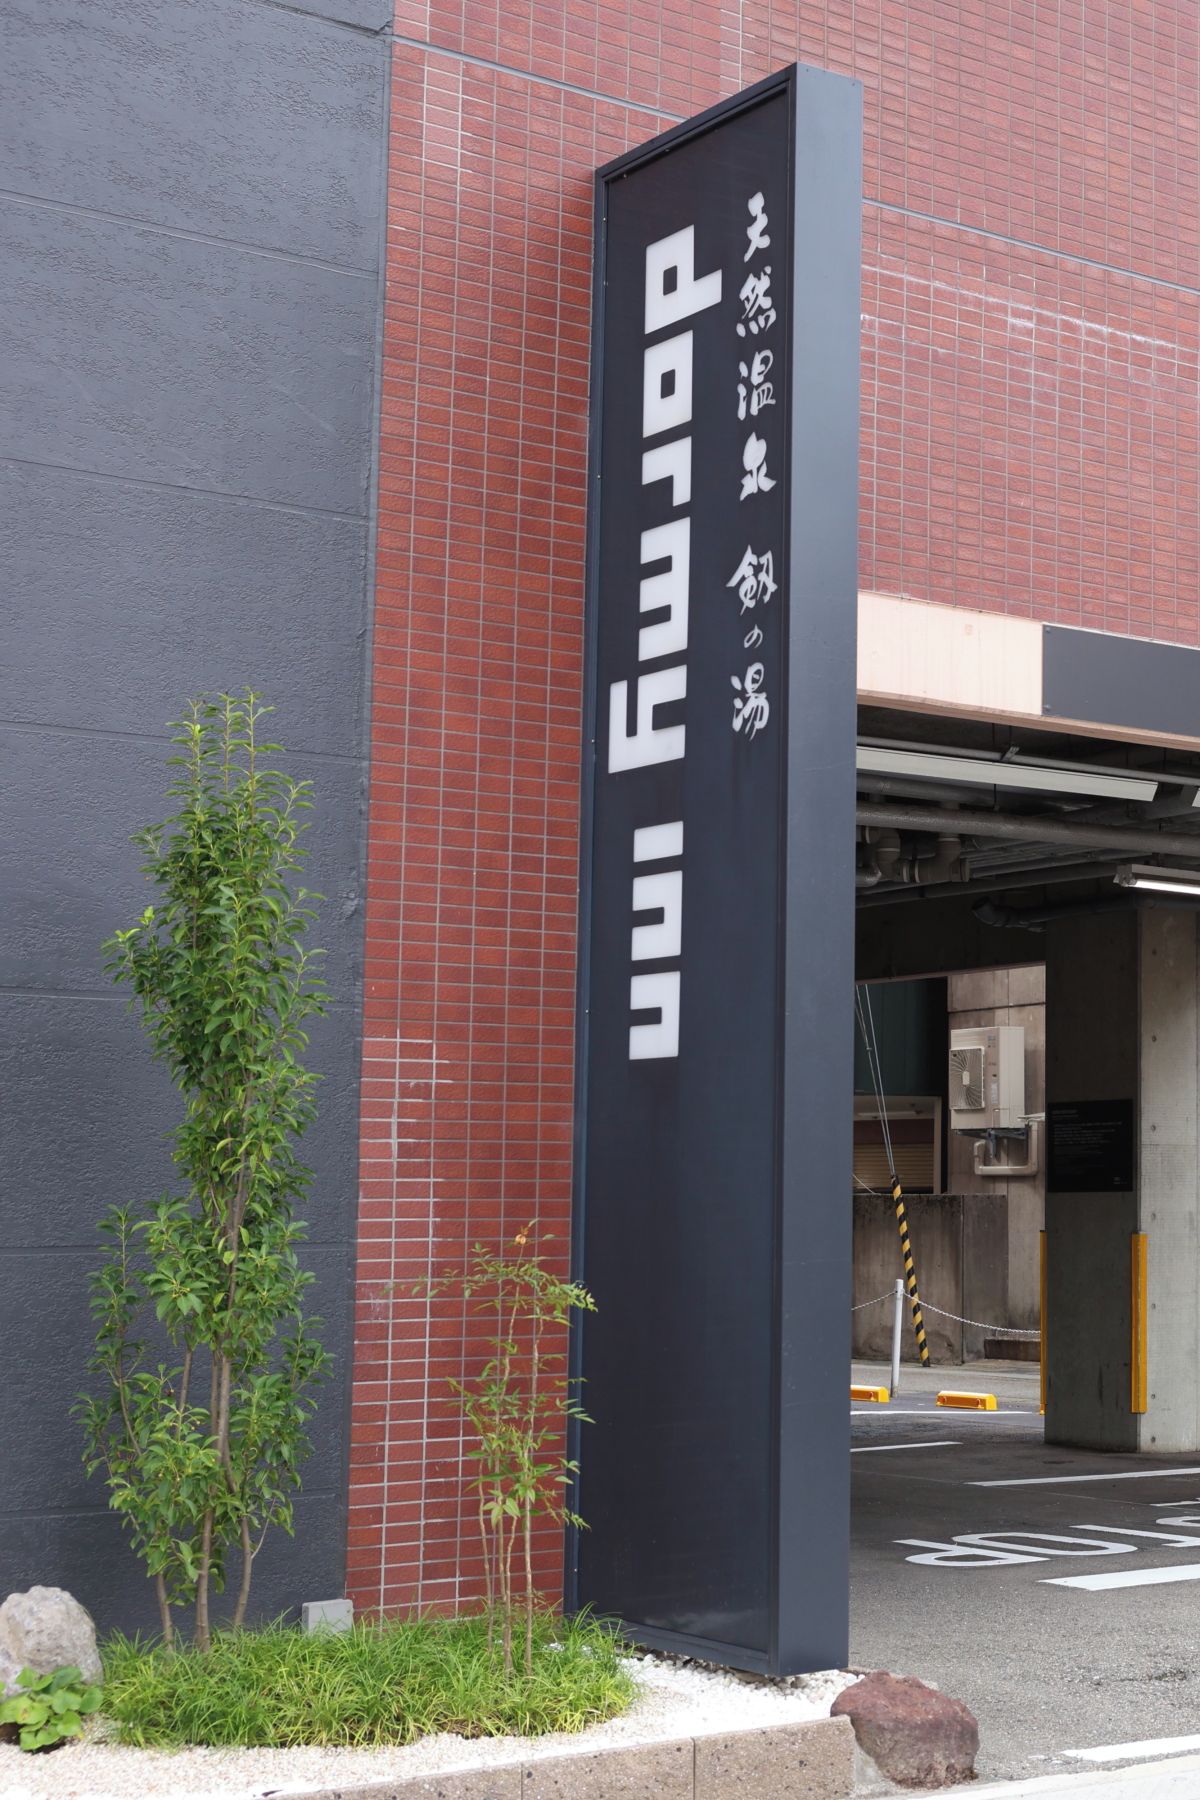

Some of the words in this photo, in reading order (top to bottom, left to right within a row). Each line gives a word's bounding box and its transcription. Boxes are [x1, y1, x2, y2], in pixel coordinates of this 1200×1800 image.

[736, 191, 777, 501] 天然温泉
[629, 820, 684, 1061] inn
